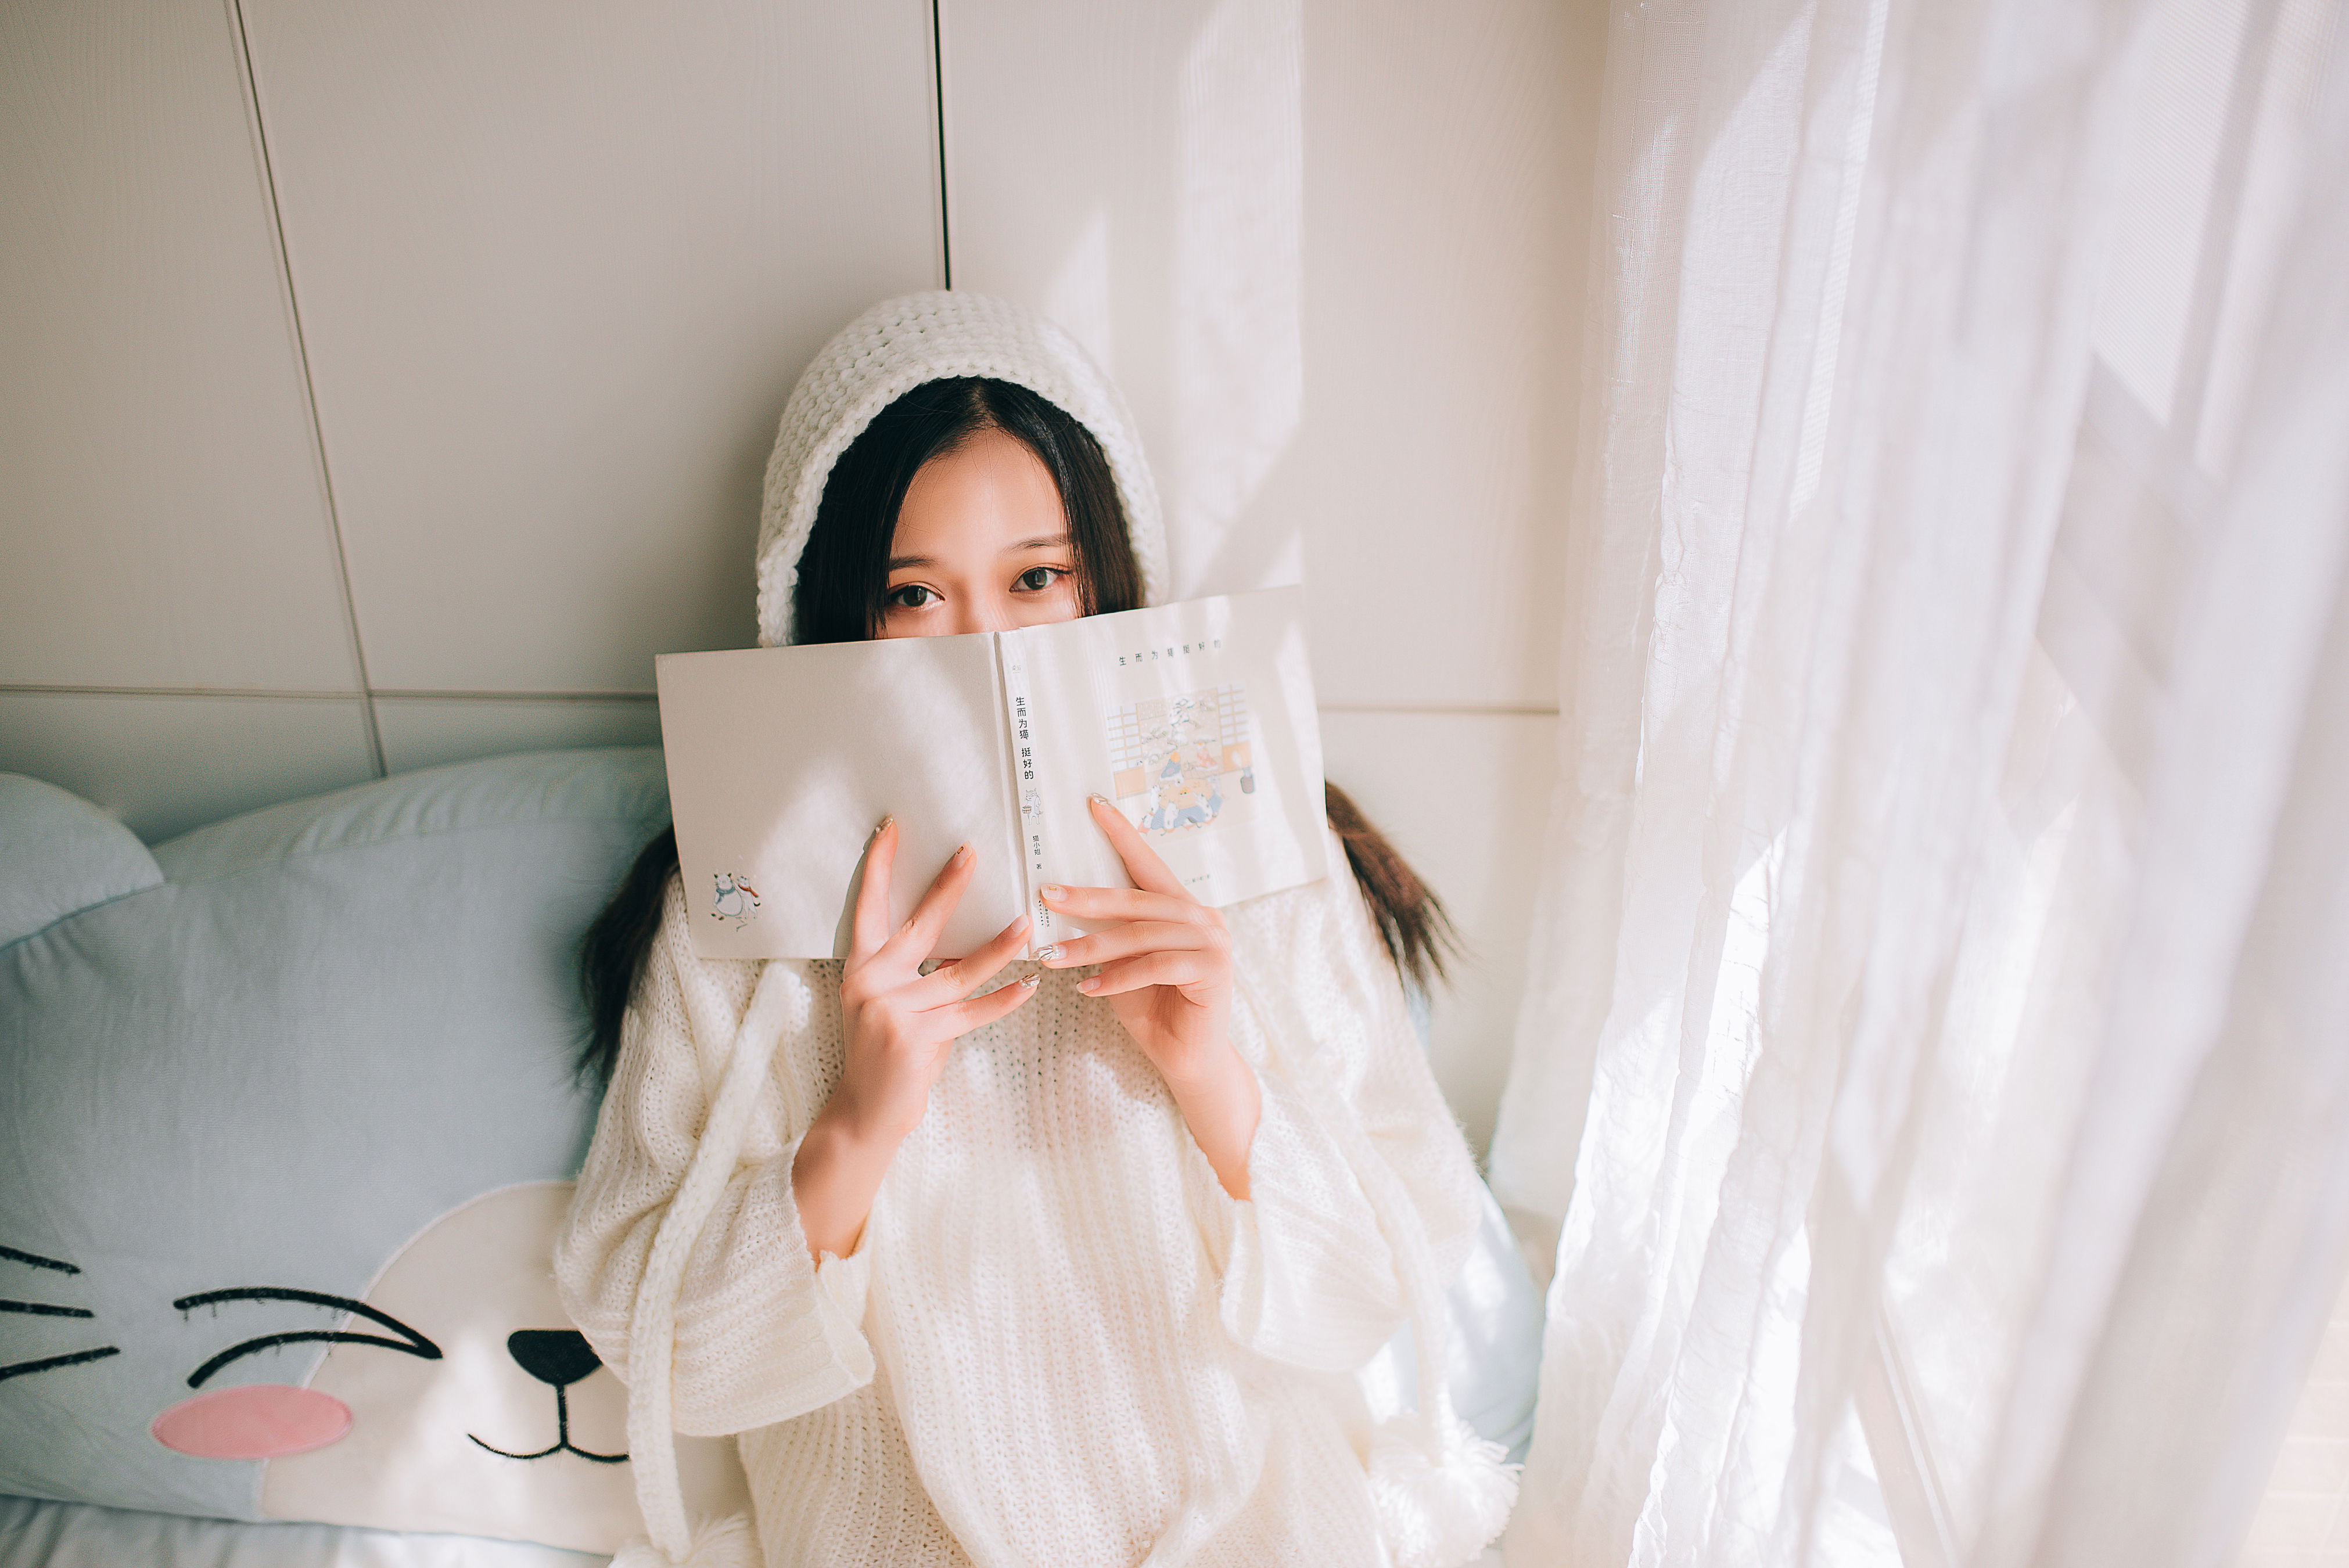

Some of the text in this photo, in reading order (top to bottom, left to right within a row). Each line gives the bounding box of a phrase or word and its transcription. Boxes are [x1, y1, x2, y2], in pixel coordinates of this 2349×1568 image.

[1021, 747, 1034, 780] 挺好的
[1032, 835, 1041, 855] 猫小姐
